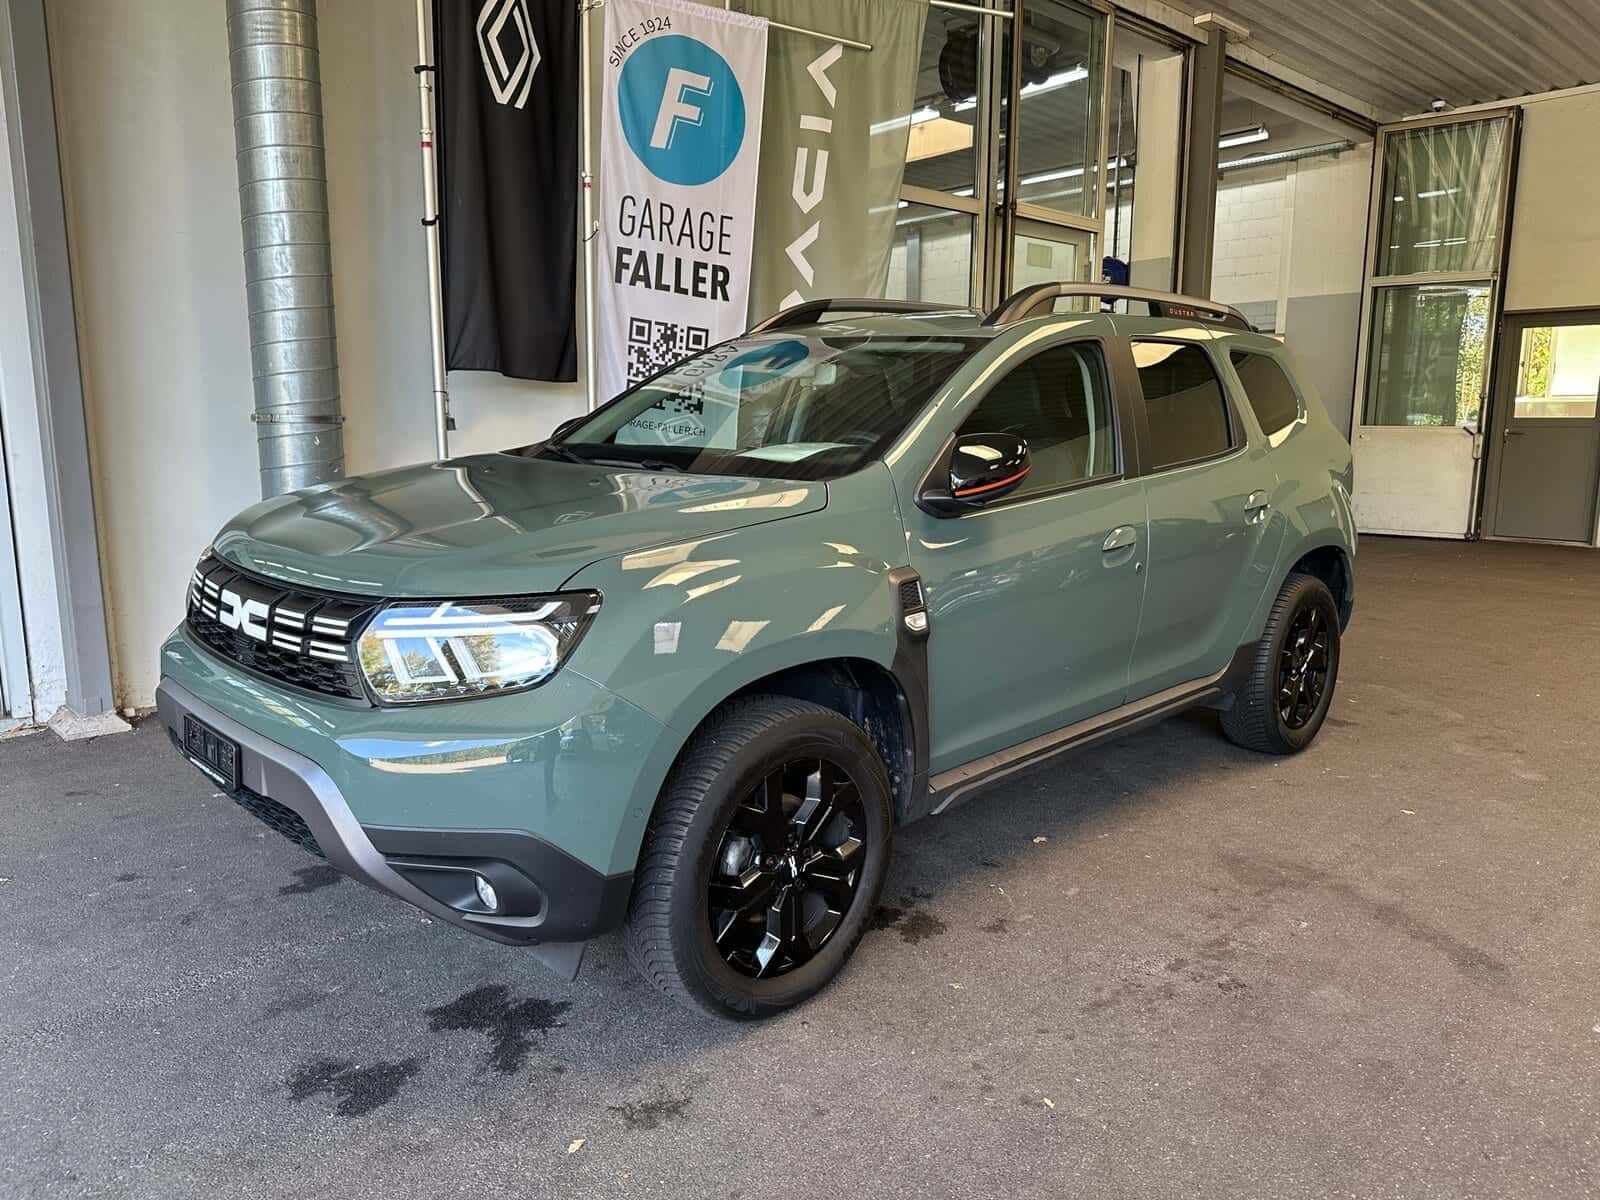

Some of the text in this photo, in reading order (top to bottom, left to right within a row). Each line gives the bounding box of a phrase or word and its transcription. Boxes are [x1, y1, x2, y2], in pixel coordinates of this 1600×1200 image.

[609, 16, 672, 67] SINCE 1924
[619, 195, 733, 255] GARAGE
[614, 246, 730, 302] FALLER
[630, 419, 706, 437] RAGE-FALLER.CH
